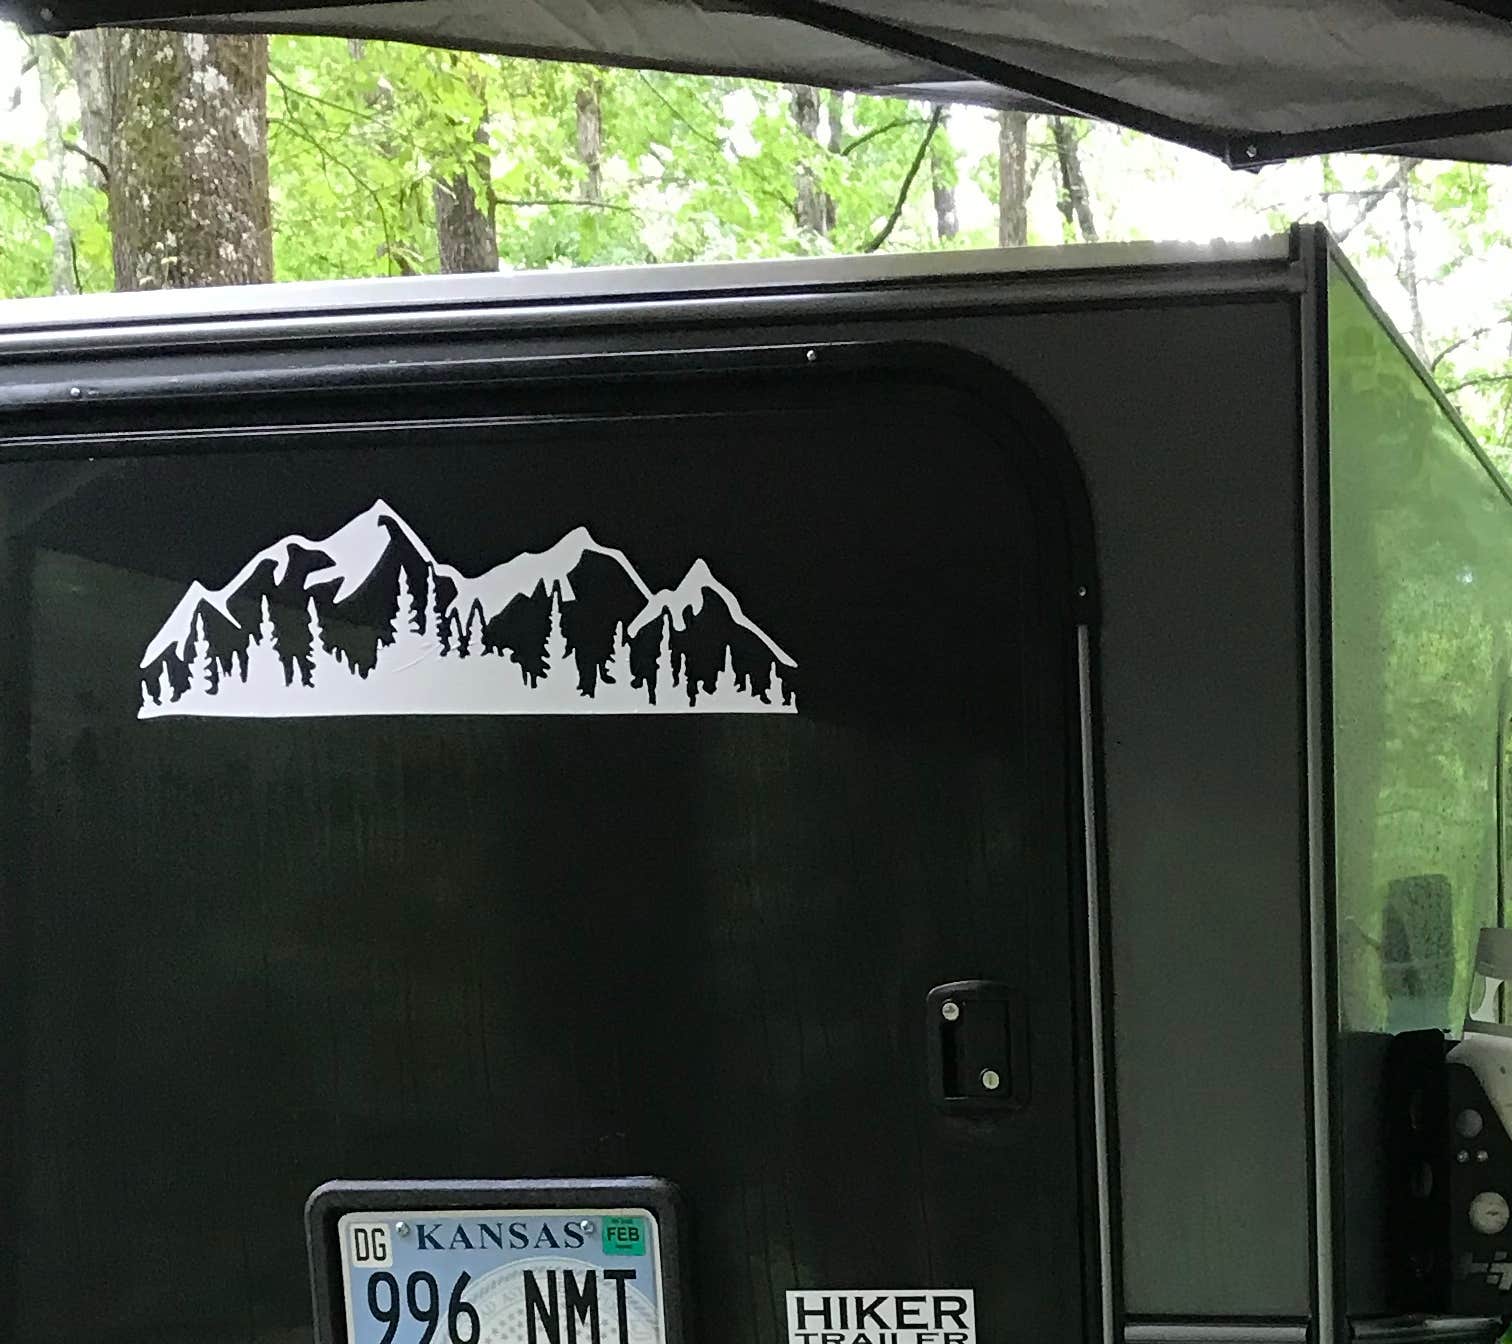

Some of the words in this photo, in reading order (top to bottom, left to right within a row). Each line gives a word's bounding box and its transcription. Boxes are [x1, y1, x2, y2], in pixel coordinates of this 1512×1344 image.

[354, 1228, 387, 1262] DG
[416, 1221, 585, 1250] KANSAS
[607, 1226, 640, 1242] FEB
[795, 1296, 969, 1330] HIKER
